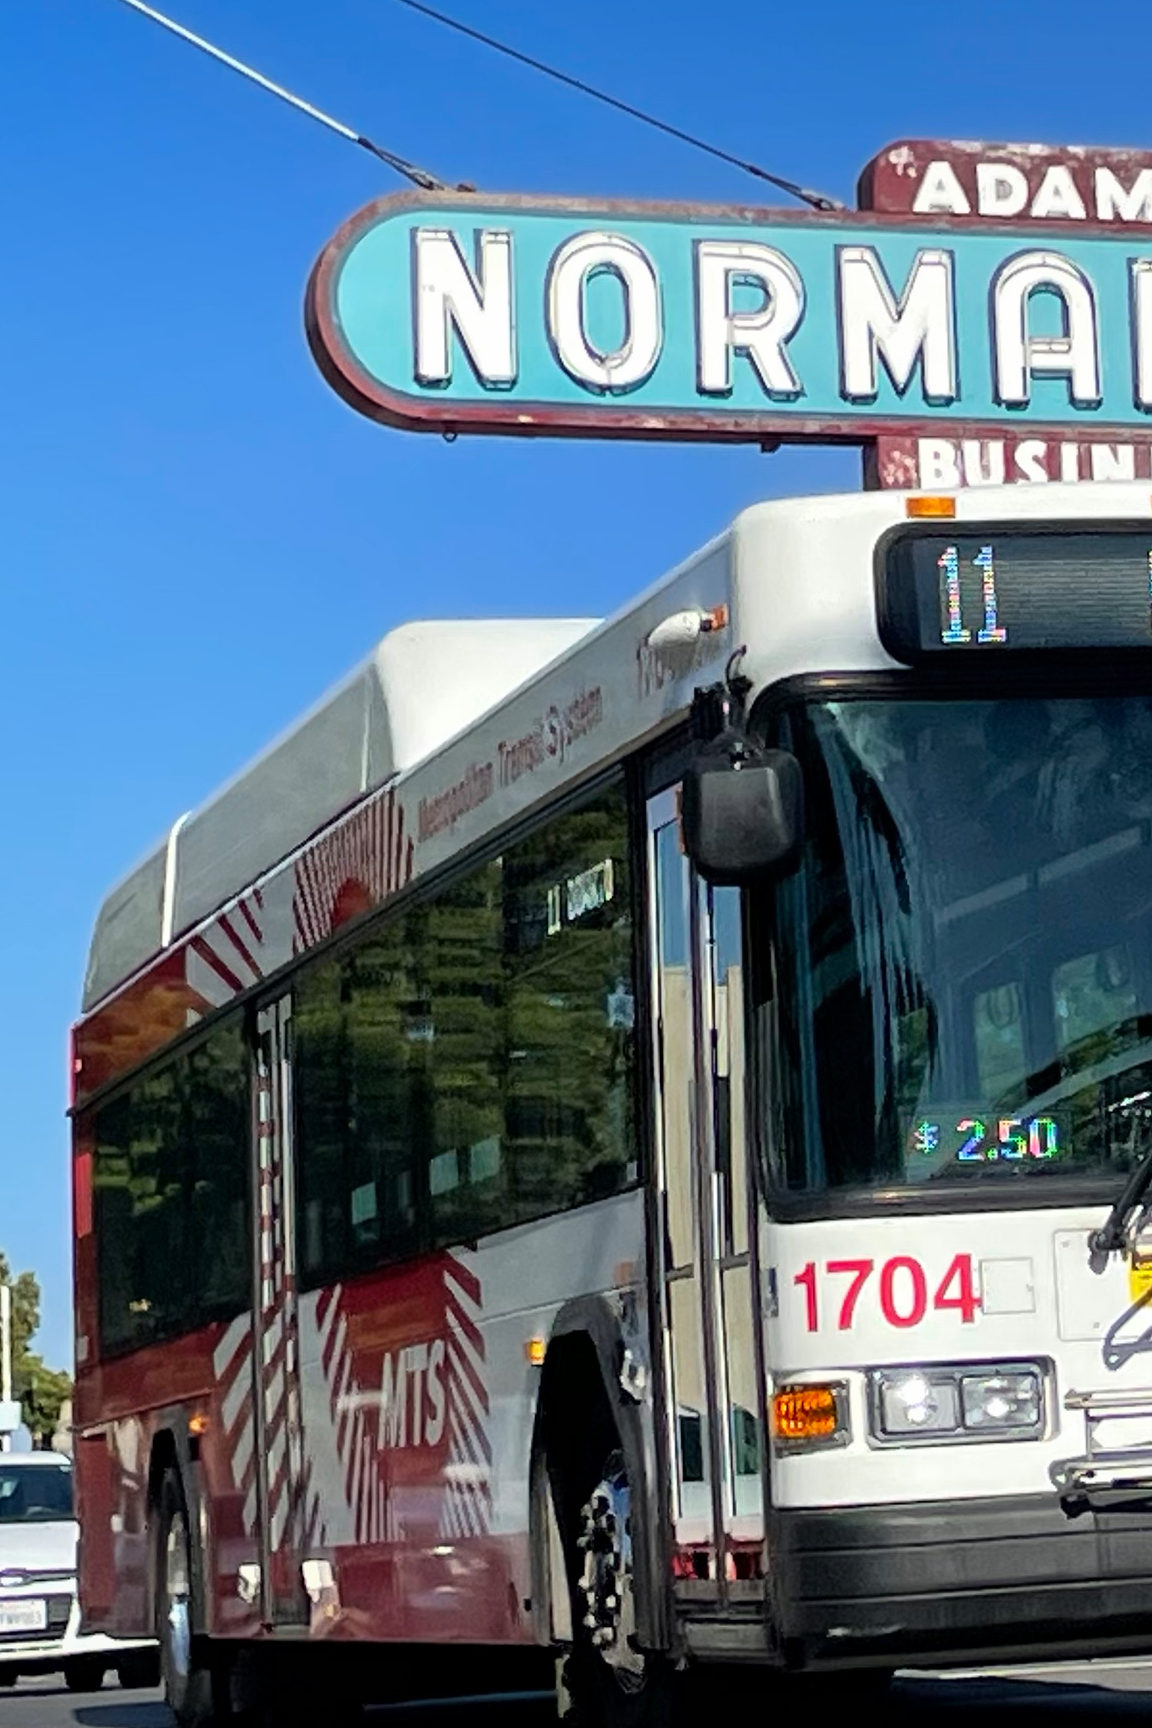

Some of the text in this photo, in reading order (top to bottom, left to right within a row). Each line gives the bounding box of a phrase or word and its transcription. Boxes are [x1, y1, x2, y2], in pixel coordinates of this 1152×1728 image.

[938, 545, 1006, 643] 11
[956, 1116, 1060, 1162] 2.50
[794, 1253, 982, 1333] 1704
[377, 1338, 446, 1451] MTS
